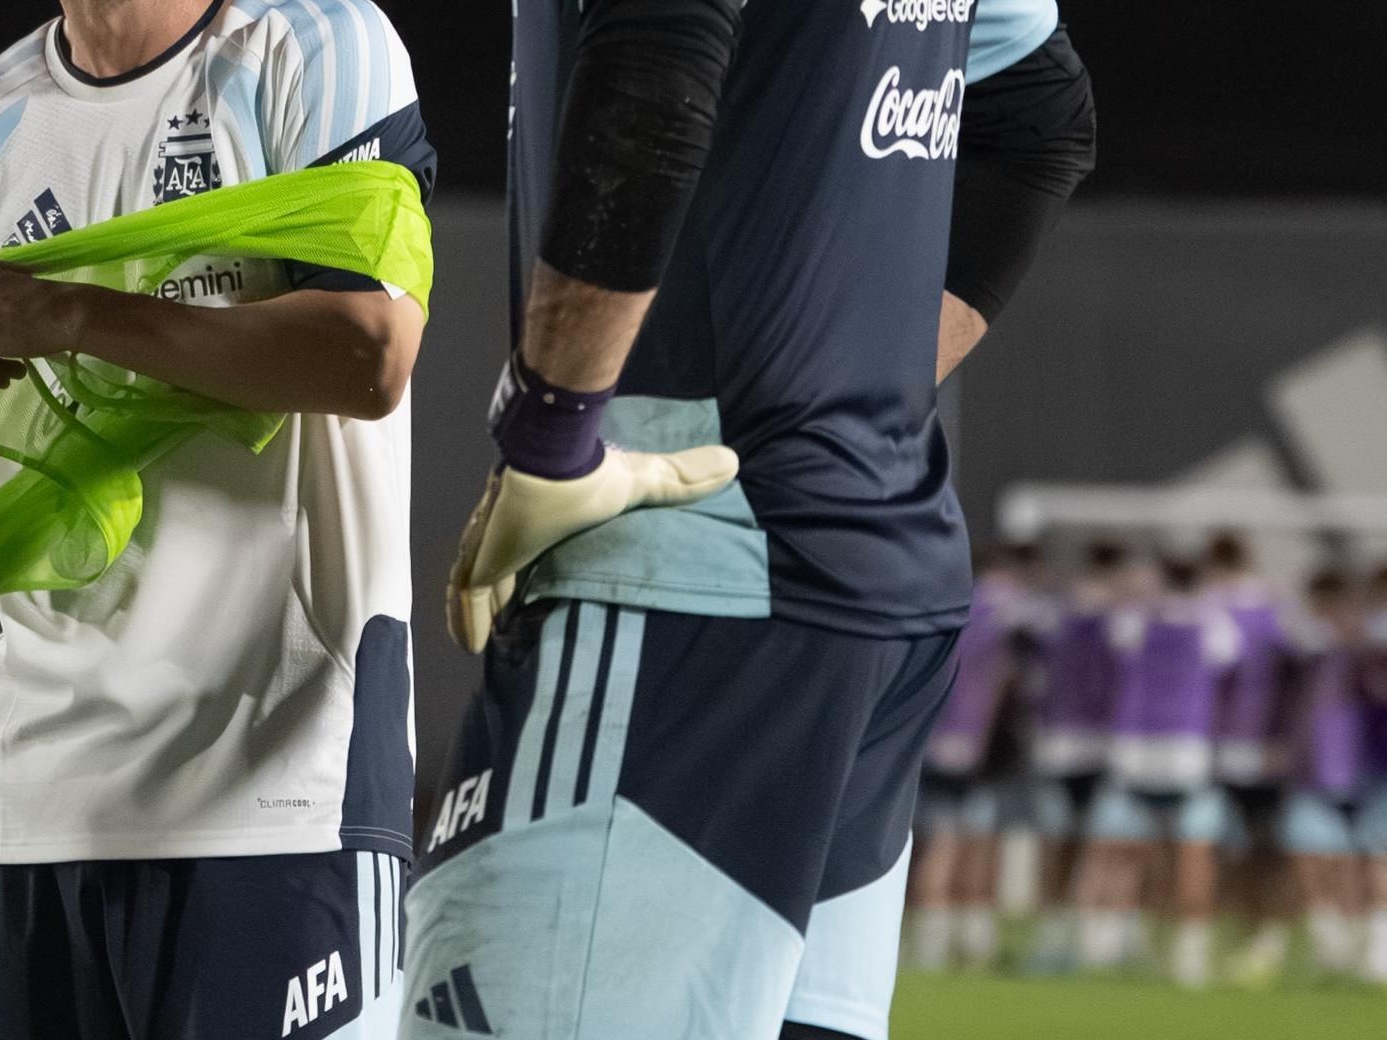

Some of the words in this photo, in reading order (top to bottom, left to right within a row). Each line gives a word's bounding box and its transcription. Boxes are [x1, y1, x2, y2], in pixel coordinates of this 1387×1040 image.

[166, 156, 207, 195] AFA
[154, 261, 243, 301] emini
[427, 768, 493, 854] AFA
[281, 950, 348, 1038] AFA
